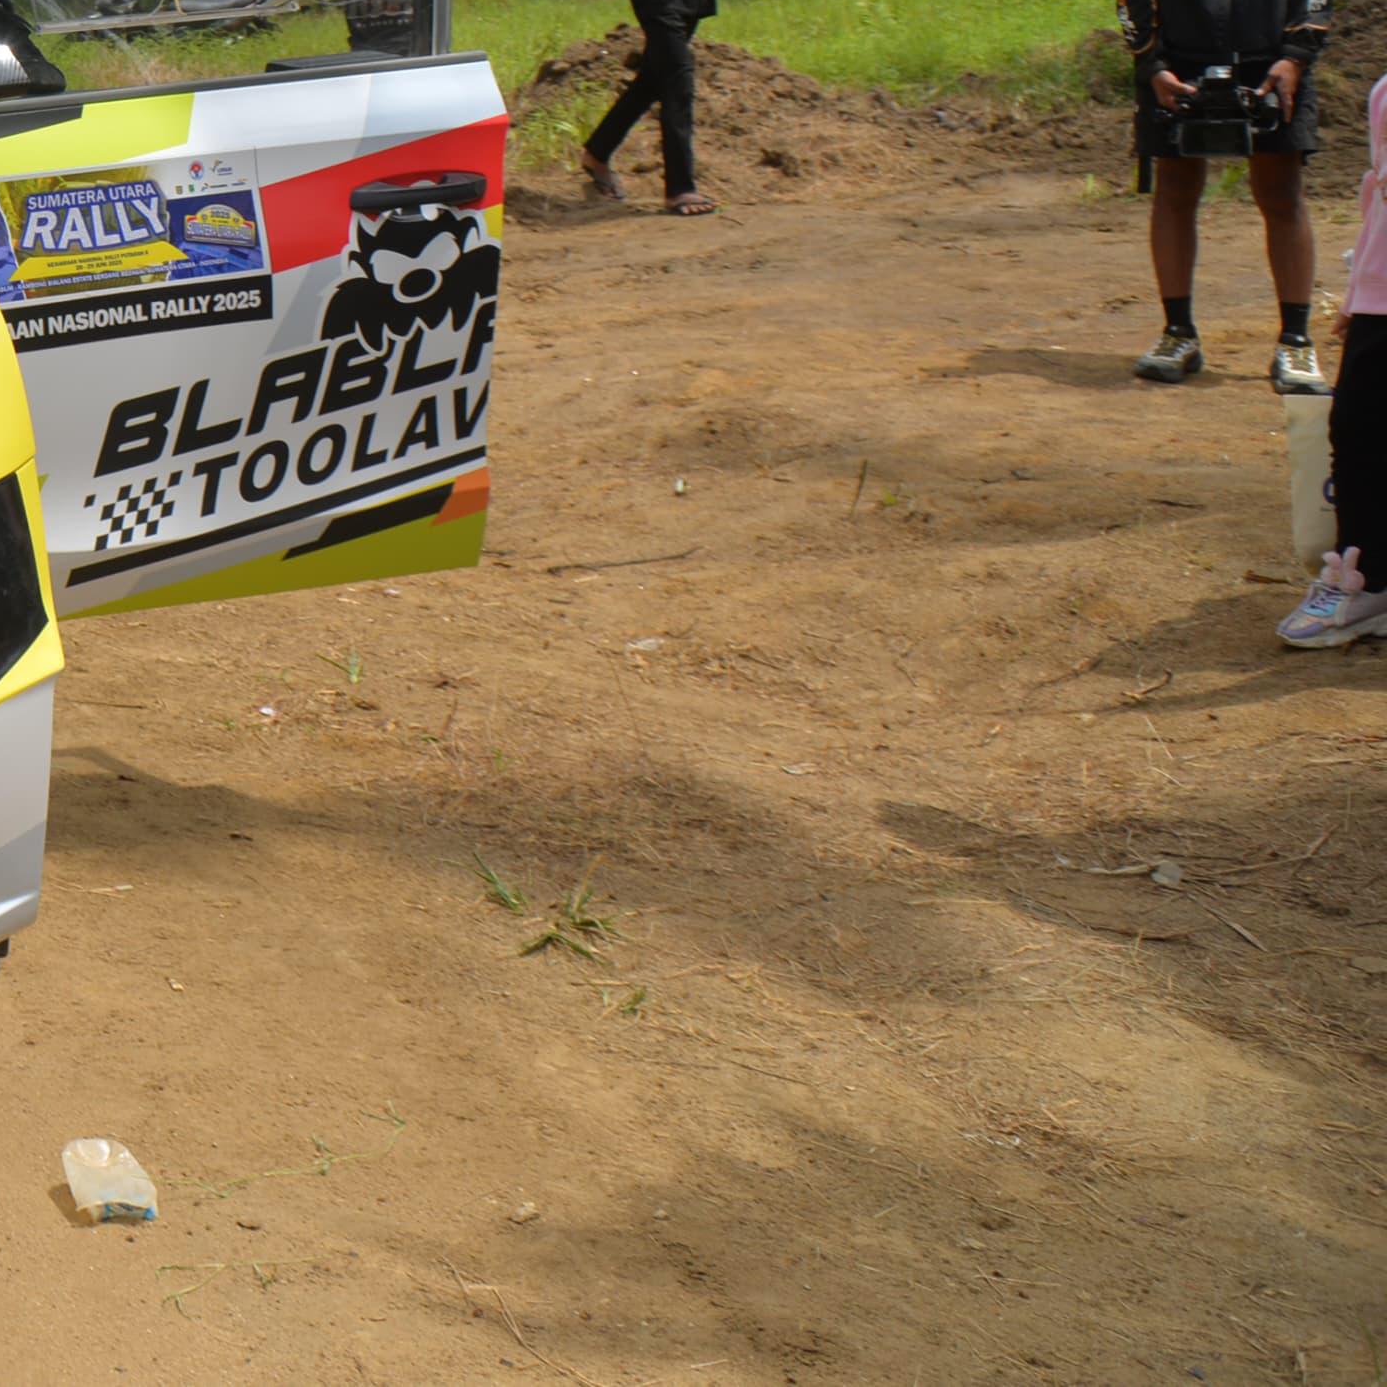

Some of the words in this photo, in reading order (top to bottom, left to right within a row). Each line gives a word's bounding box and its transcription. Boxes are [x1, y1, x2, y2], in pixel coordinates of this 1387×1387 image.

[27, 192, 105, 210] SUMATERA
[108, 182, 156, 202] UTARA
[22, 196, 167, 250] RALLY
[47, 305, 150, 334] NASIONAL
[150, 295, 212, 319] RALLY
[213, 289, 262, 312] 2025
